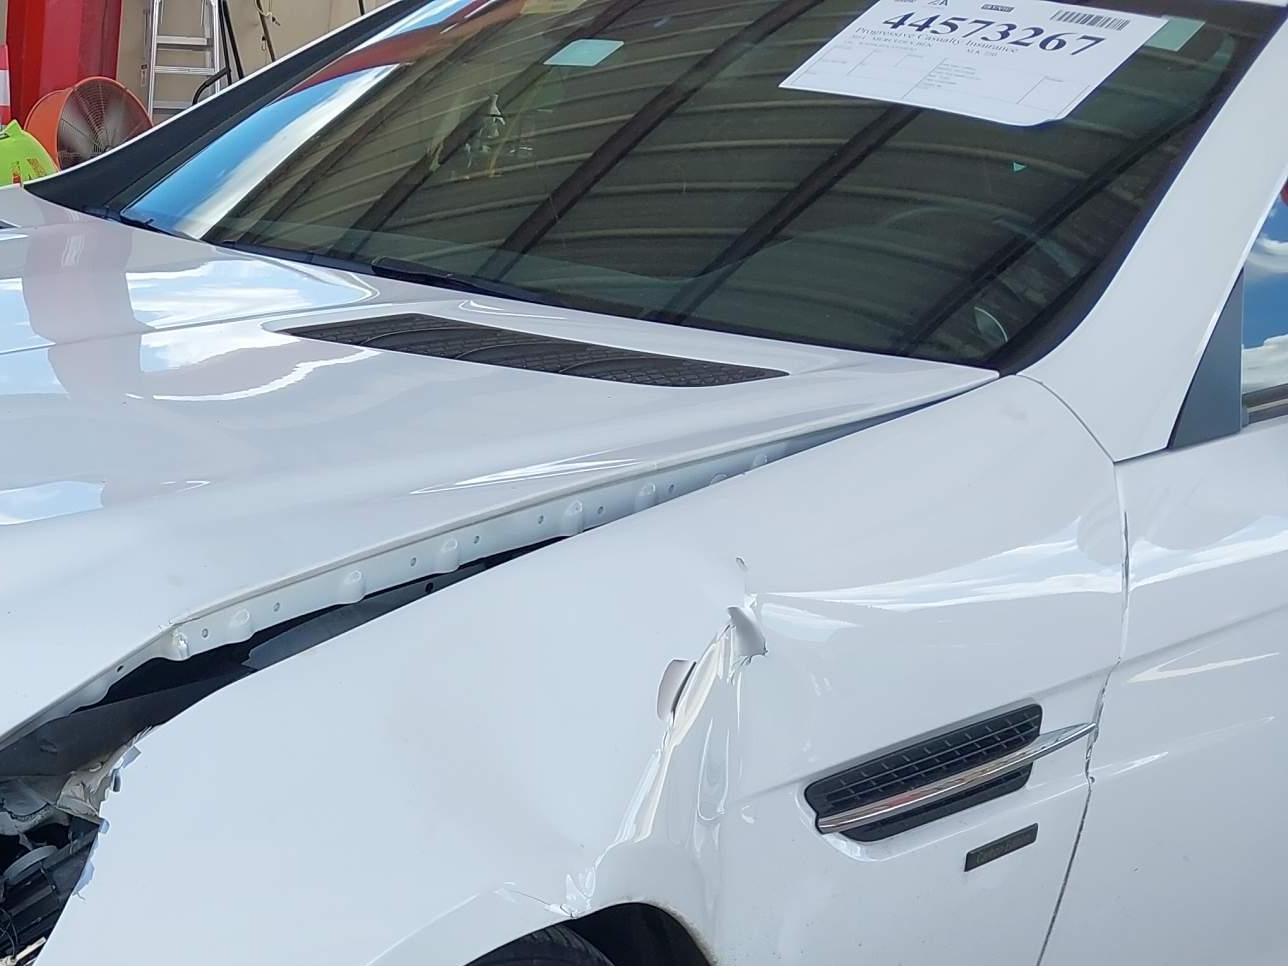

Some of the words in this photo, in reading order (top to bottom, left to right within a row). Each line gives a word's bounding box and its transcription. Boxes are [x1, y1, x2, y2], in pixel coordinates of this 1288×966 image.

[855, 26, 913, 41] Progressive
[915, 33, 962, 47] Casualty
[965, 39, 1019, 54] Insurance
[883, 12, 1106, 56] 44573267
